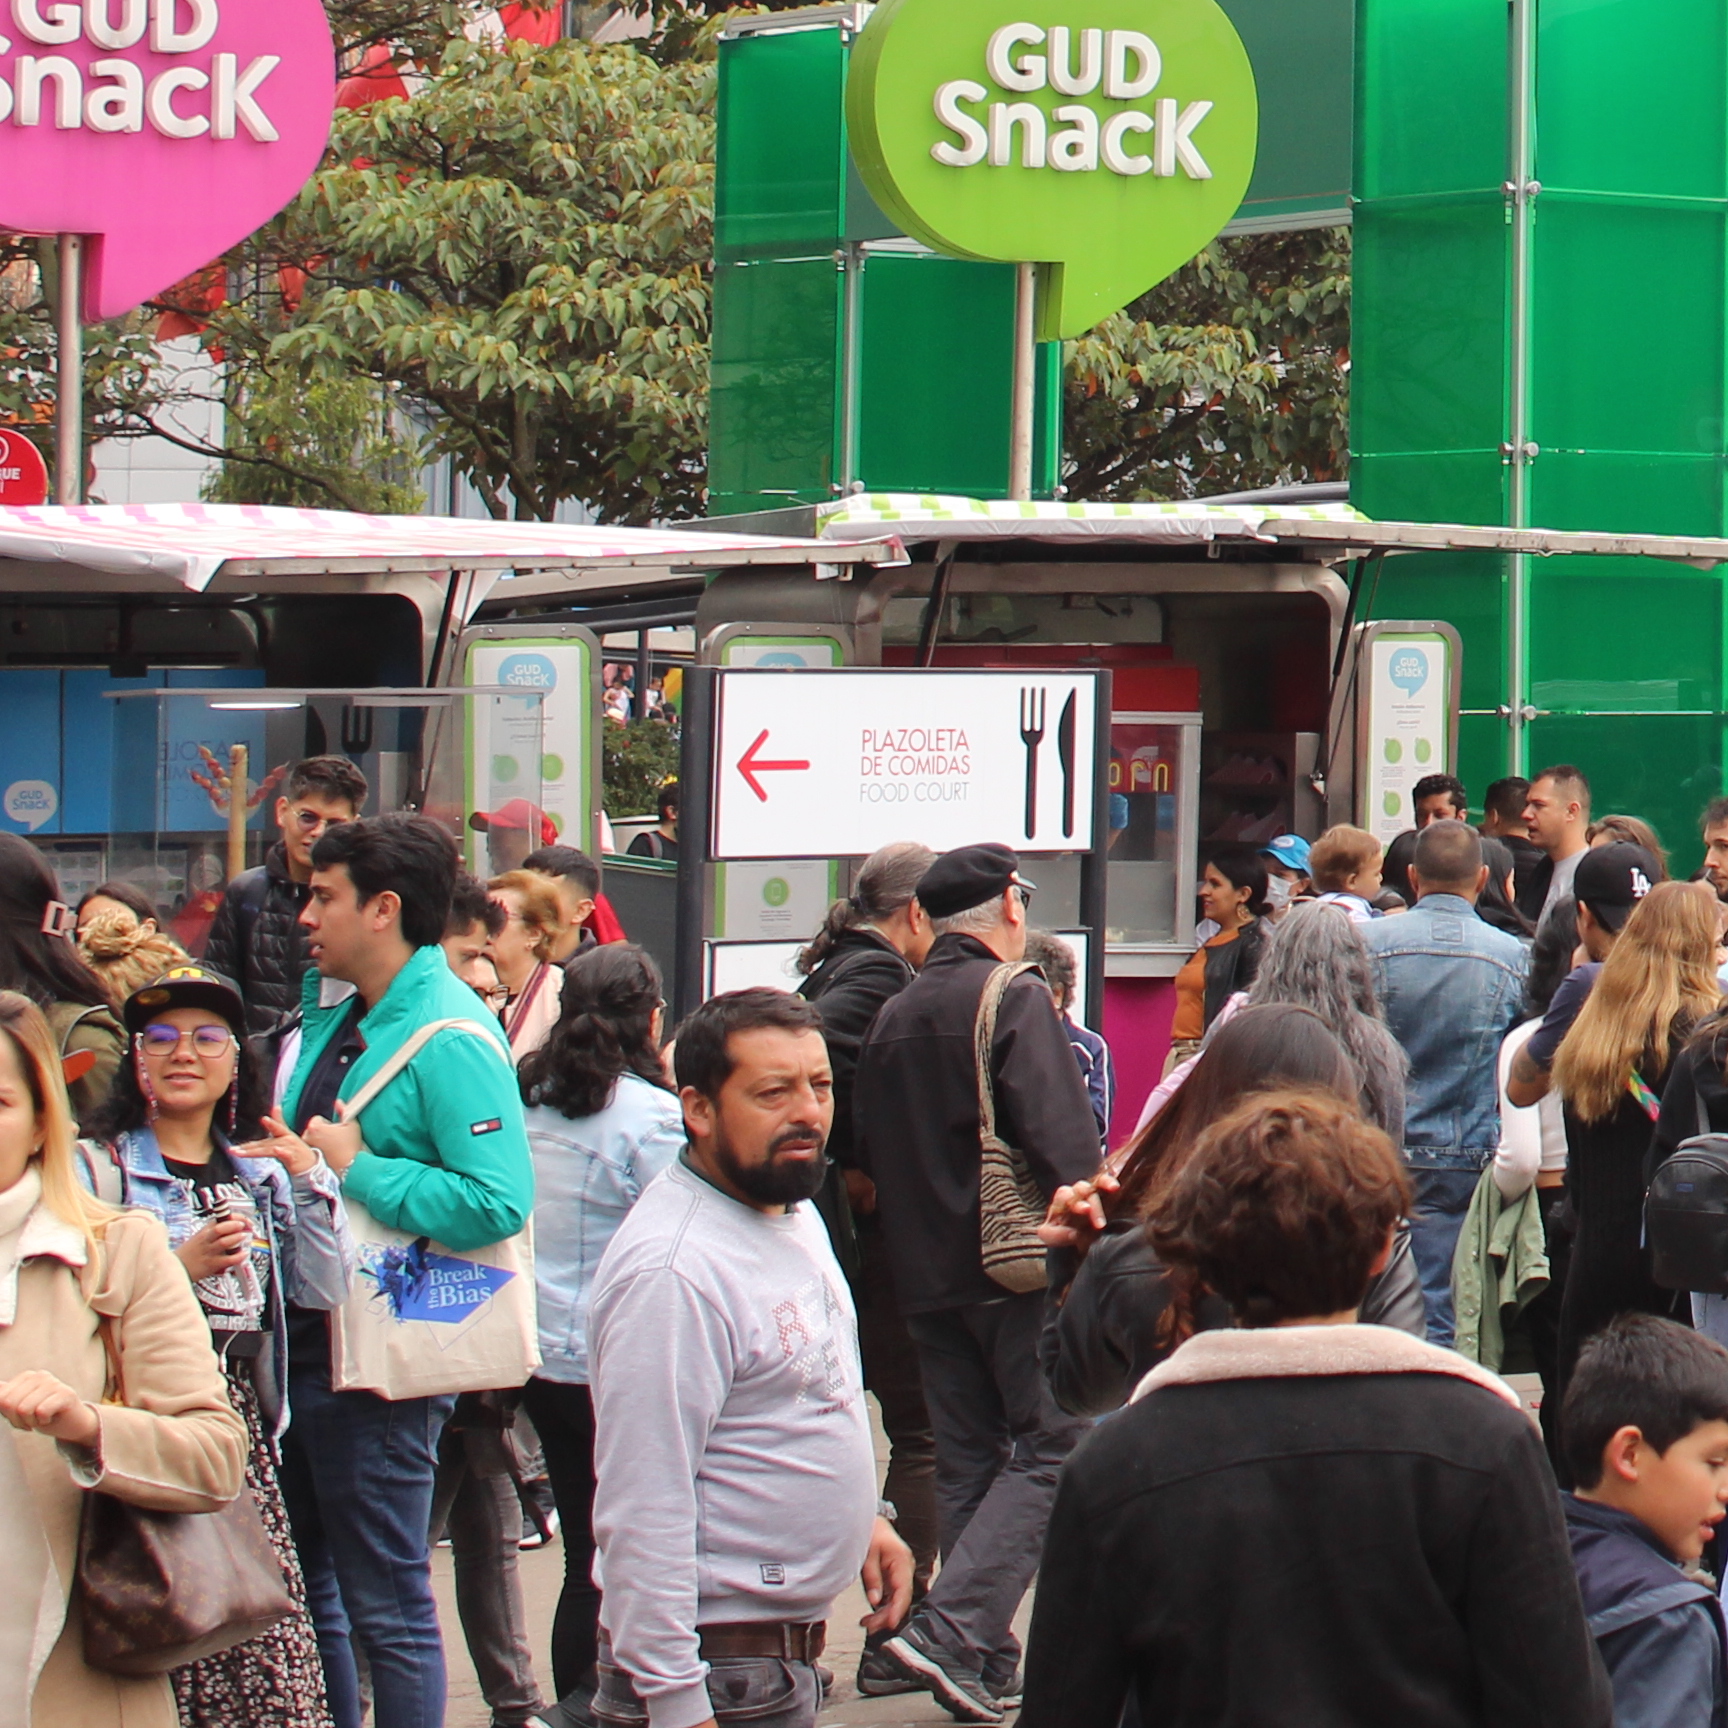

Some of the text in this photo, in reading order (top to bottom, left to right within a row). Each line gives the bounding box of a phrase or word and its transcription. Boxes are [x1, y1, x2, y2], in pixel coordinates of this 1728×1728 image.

[985, 22, 1162, 99] GUD
[0, 33, 281, 143] nacK
[514, 663, 542, 675] GUD
[862, 728, 970, 752] PLAZOLETA
[861, 754, 970, 776] DE COMIDAS
[859, 782, 970, 803] FOOD COURT
[1630, 867, 1653, 897] LA
[429, 1263, 488, 1286] Break
[428, 1287, 441, 1309] the
[439, 1283, 493, 1308] Bias
